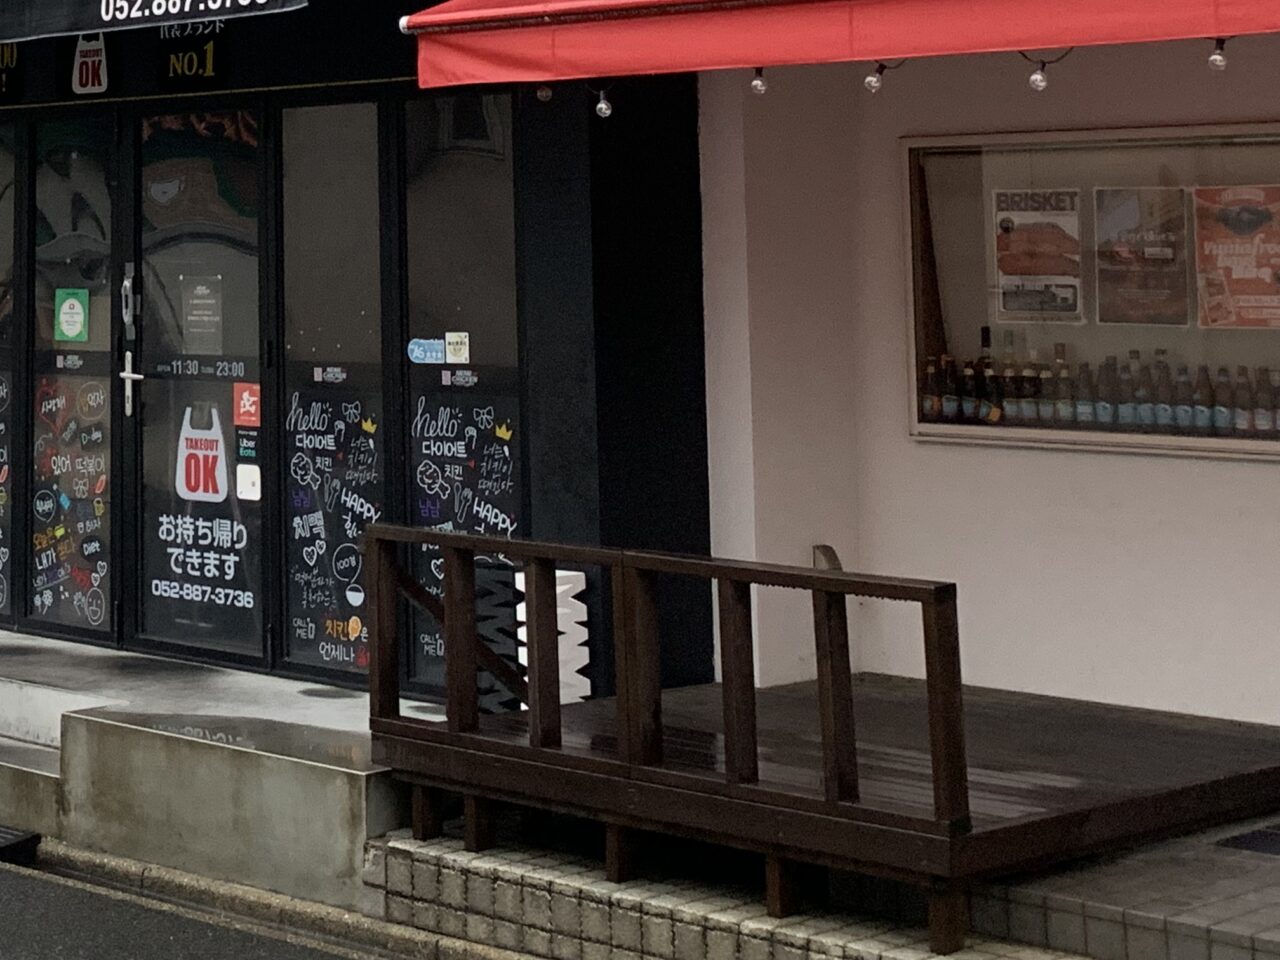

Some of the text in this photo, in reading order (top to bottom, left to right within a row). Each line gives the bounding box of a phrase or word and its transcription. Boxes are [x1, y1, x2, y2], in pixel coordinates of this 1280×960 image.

[168, 41, 216, 78] NO.1
[78, 59, 103, 89] OK
[997, 191, 1078, 212] BRISKET
[171, 360, 199, 375] 11:30
[216, 361, 245, 377] 23:00
[286, 392, 328, 431] hello
[412, 396, 458, 438] hello
[184, 437, 219, 451] TAKEOUT
[296, 433, 336, 450] 다이어트
[422, 440, 467, 457] 다이어트
[184, 452, 220, 494] OK
[315, 456, 332, 471] 치킨
[444, 464, 463, 480] 치킨
[340, 487, 381, 525] HAPPY
[293, 511, 325, 539] 치맥
[473, 496, 518, 540] HAPPY
[158, 514, 247, 549] お持ち帰り
[83, 540, 100, 556] Diet
[167, 547, 240, 580] できます
[151, 579, 255, 609] 052-887-3736
[293, 618, 307, 628] CALL
[296, 628, 308, 639] ME
[420, 633, 436, 644] CALL
[319, 641, 355, 662] 언제나
[424, 644, 436, 656] ME
